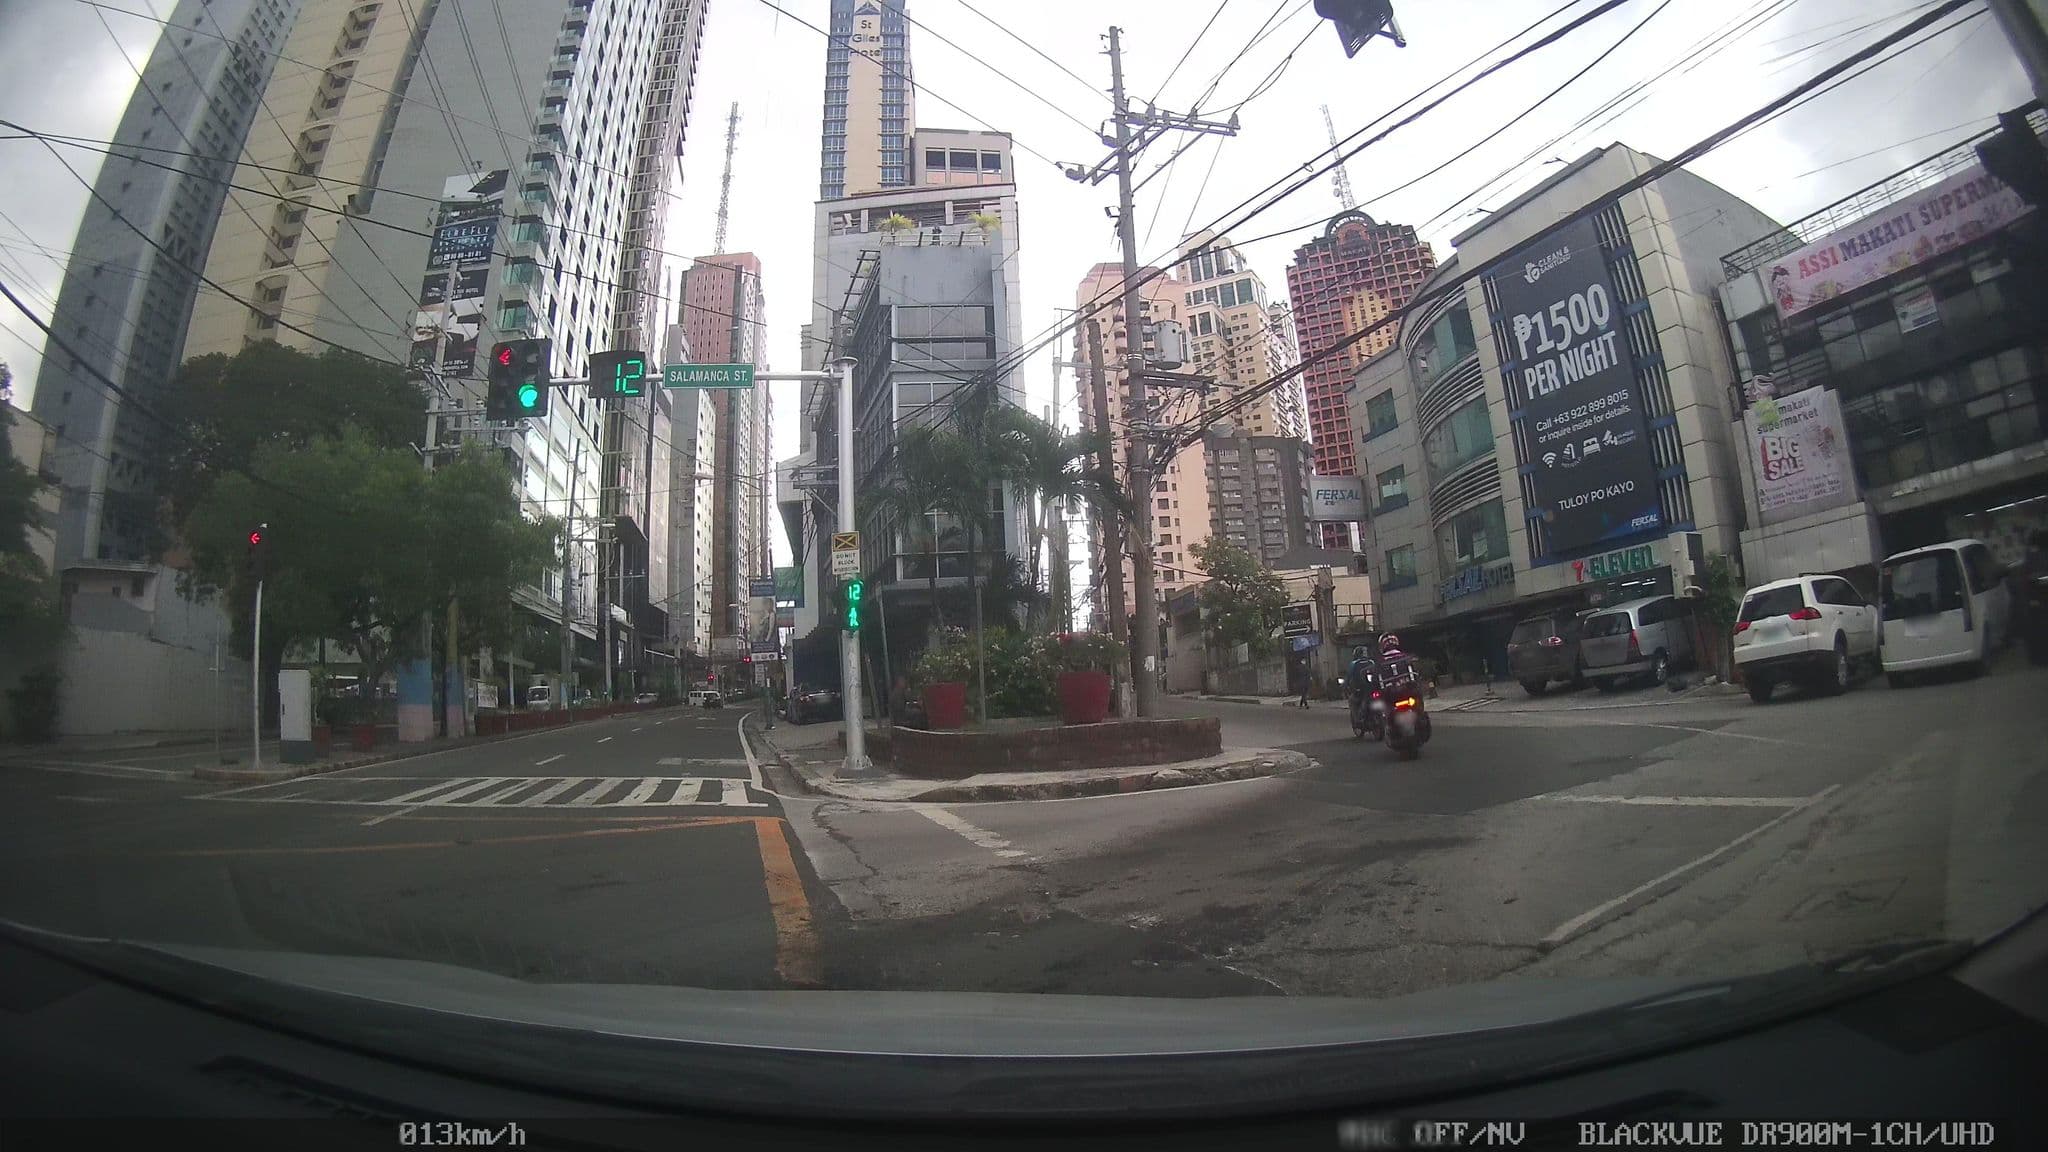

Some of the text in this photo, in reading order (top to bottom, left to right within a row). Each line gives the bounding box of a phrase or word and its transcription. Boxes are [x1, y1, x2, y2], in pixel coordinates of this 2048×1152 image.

[861, 20, 872, 29] St
[852, 33, 880, 42] Giles
[1798, 246, 1840, 279] ASSI
[1838, 211, 1916, 262] MAKATI
[1538, 250, 1563, 267] CLEAN
[1540, 254, 1571, 274] SANITIZED
[1524, 330, 1618, 400] PER NIGHT
[615, 359, 643, 394] 12
[670, 370, 748, 382] SALAMANCA ST.
[1536, 389, 1629, 432] Call +63 922 899 8015
[1778, 397, 1811, 415] makati
[1538, 434, 1547, 443] or
[1547, 426, 1571, 441] inquire
[1571, 418, 1593, 432] inside
[1593, 414, 1604, 424] for
[1757, 407, 1819, 434] supermarket
[1766, 437, 1800, 462] BIG
[1767, 457, 1805, 480] SALE
[1316, 489, 1361, 500] FERSAL
[1558, 480, 1634, 511] TULOY PO KAYO
[1631, 513, 1658, 527] FERSAL
[848, 584, 861, 600] 12
